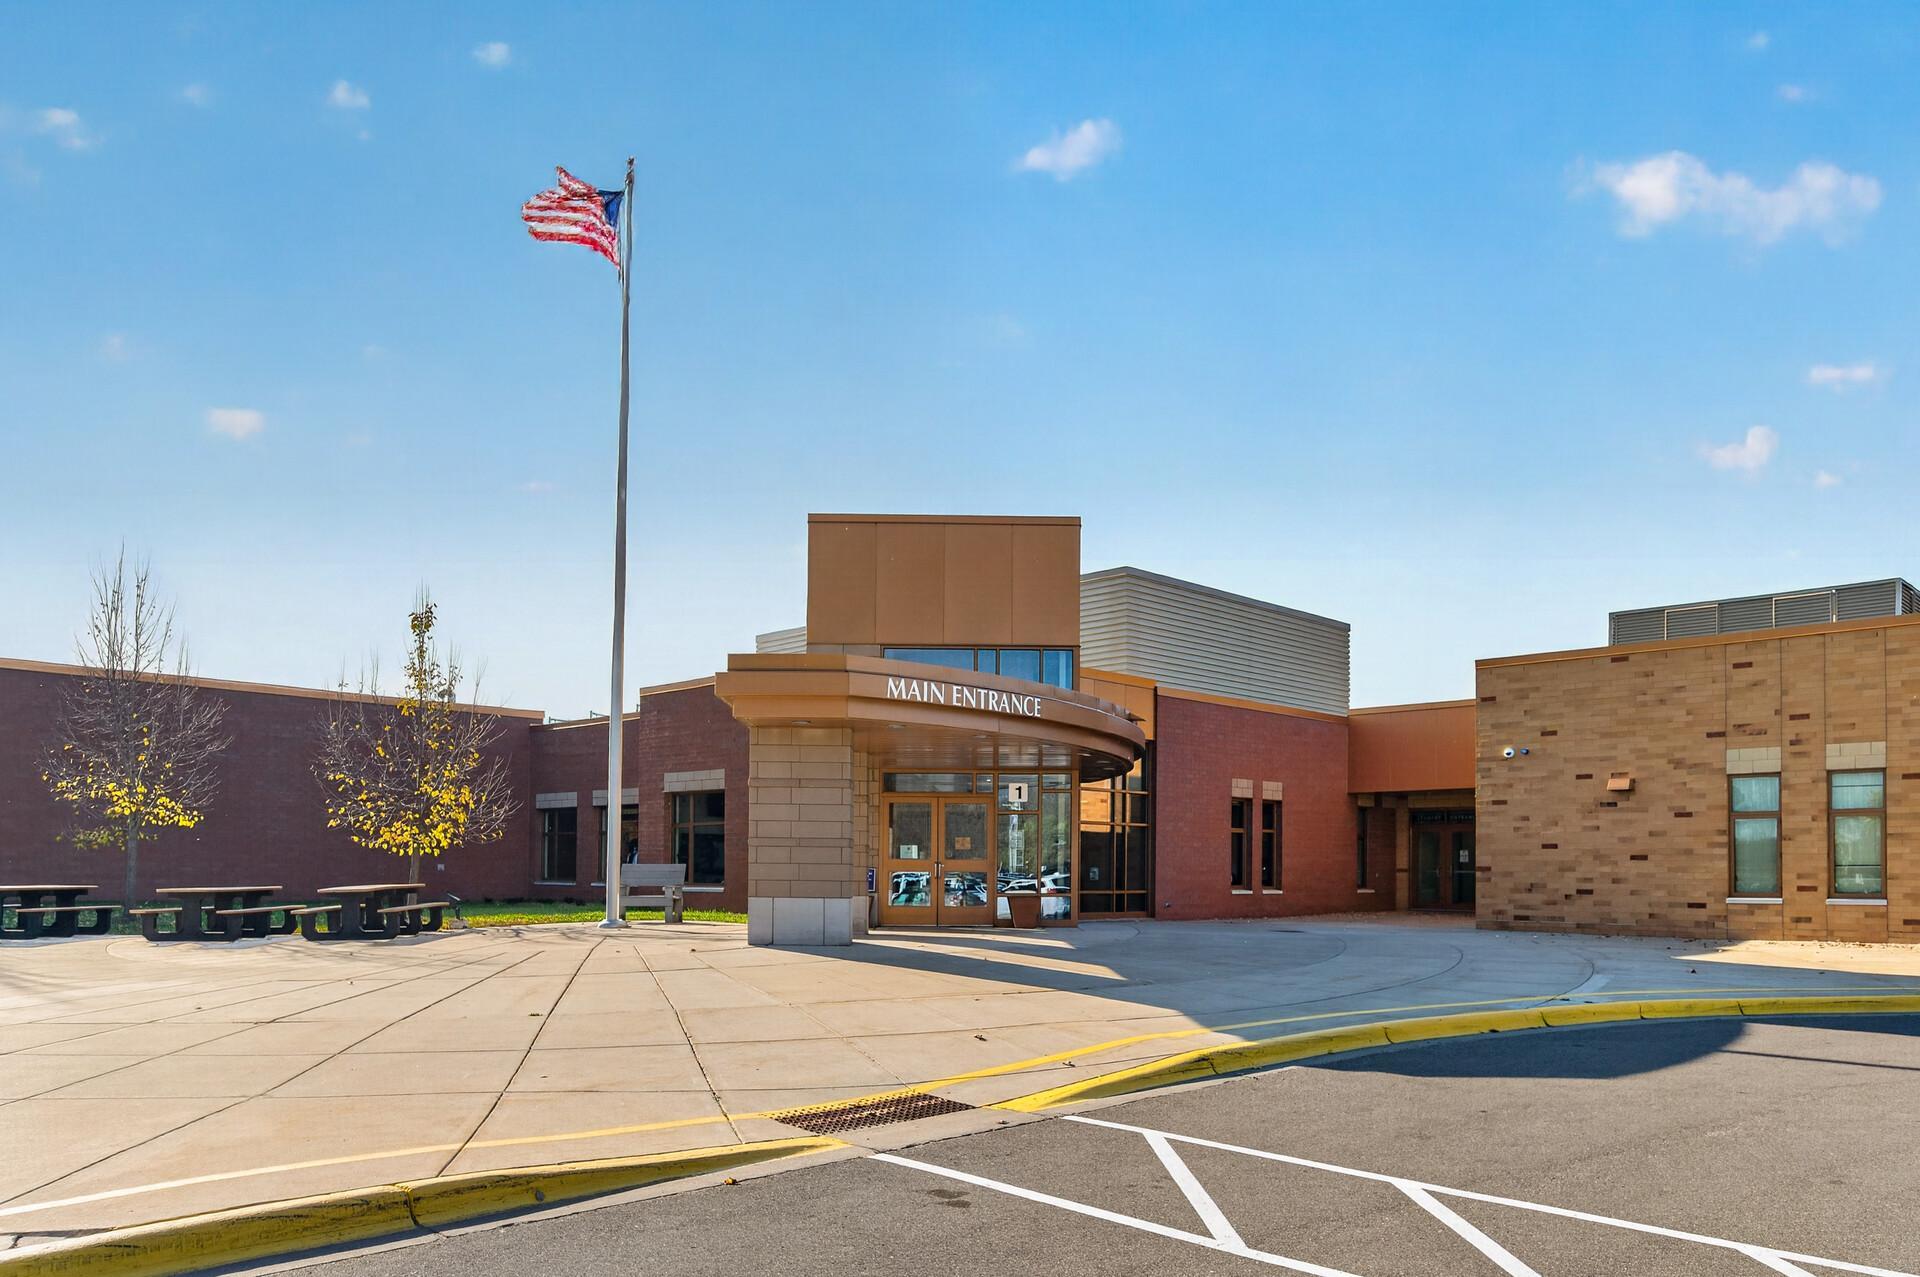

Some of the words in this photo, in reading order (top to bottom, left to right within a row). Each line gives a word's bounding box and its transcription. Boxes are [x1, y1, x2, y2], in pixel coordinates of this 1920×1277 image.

[887, 678, 945, 705] MAIN
[952, 685, 1041, 717] ENTRANCE
[1015, 785, 1022, 800] 1
